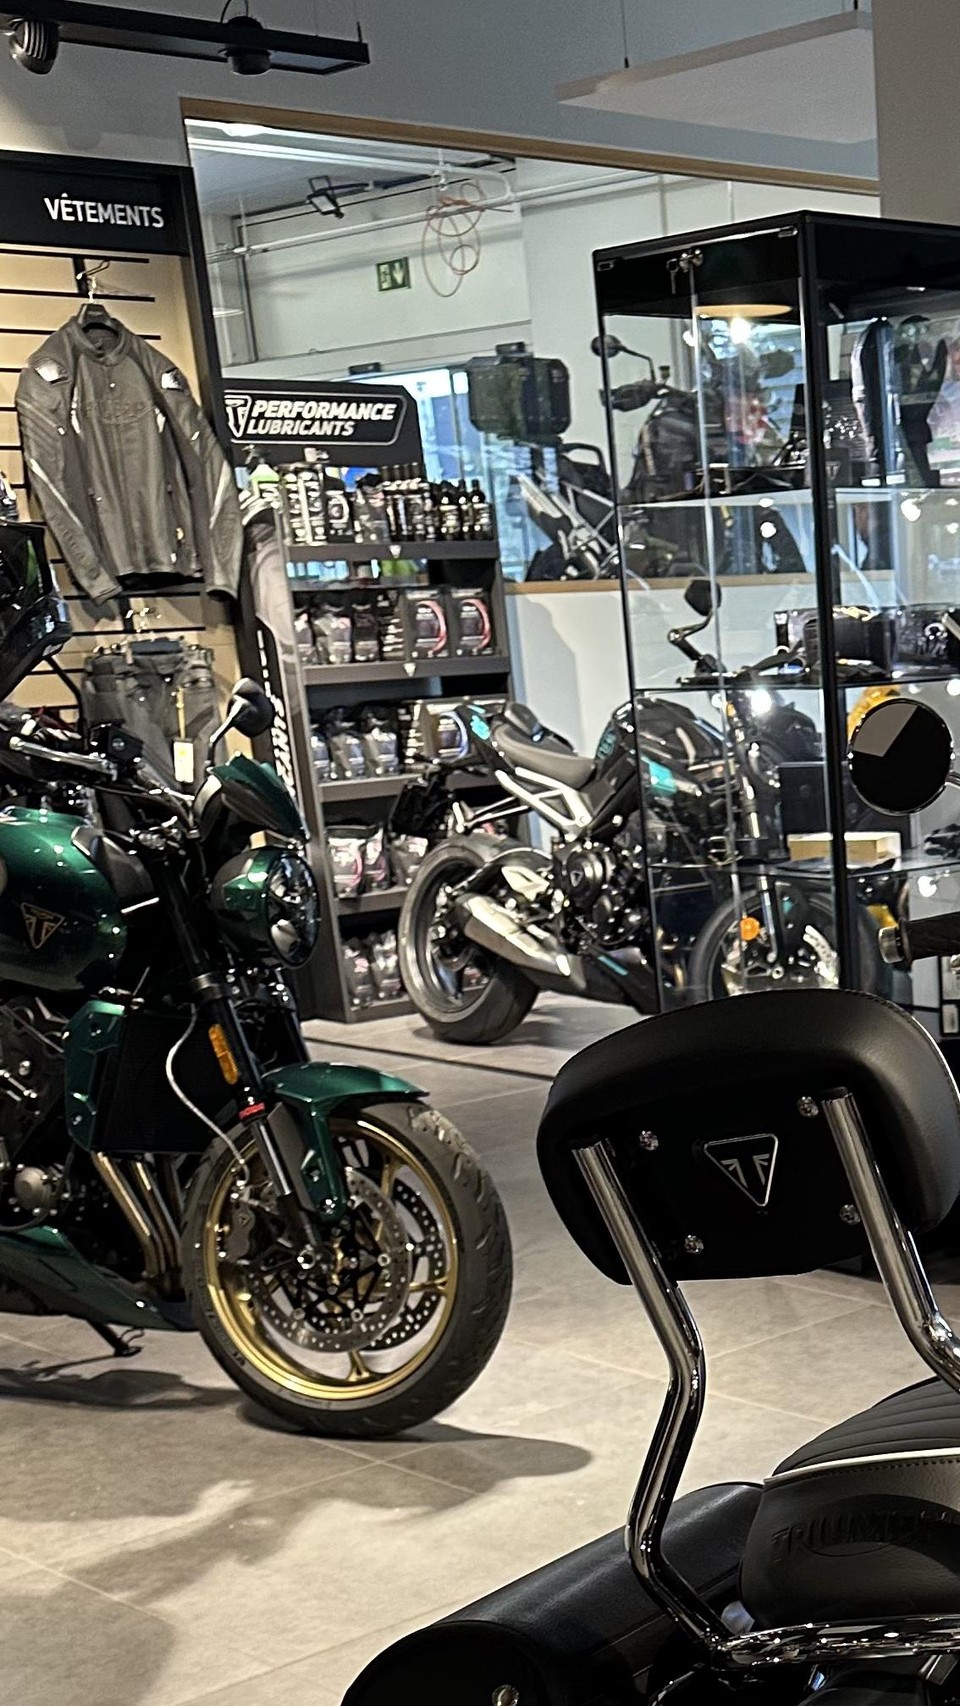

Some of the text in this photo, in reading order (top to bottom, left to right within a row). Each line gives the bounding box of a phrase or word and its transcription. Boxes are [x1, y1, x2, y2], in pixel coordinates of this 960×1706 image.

[43, 192, 164, 228] VÊTEMENTS
[250, 400, 398, 421] PERFORMANCE
[246, 419, 355, 437] LUBRICANTS
